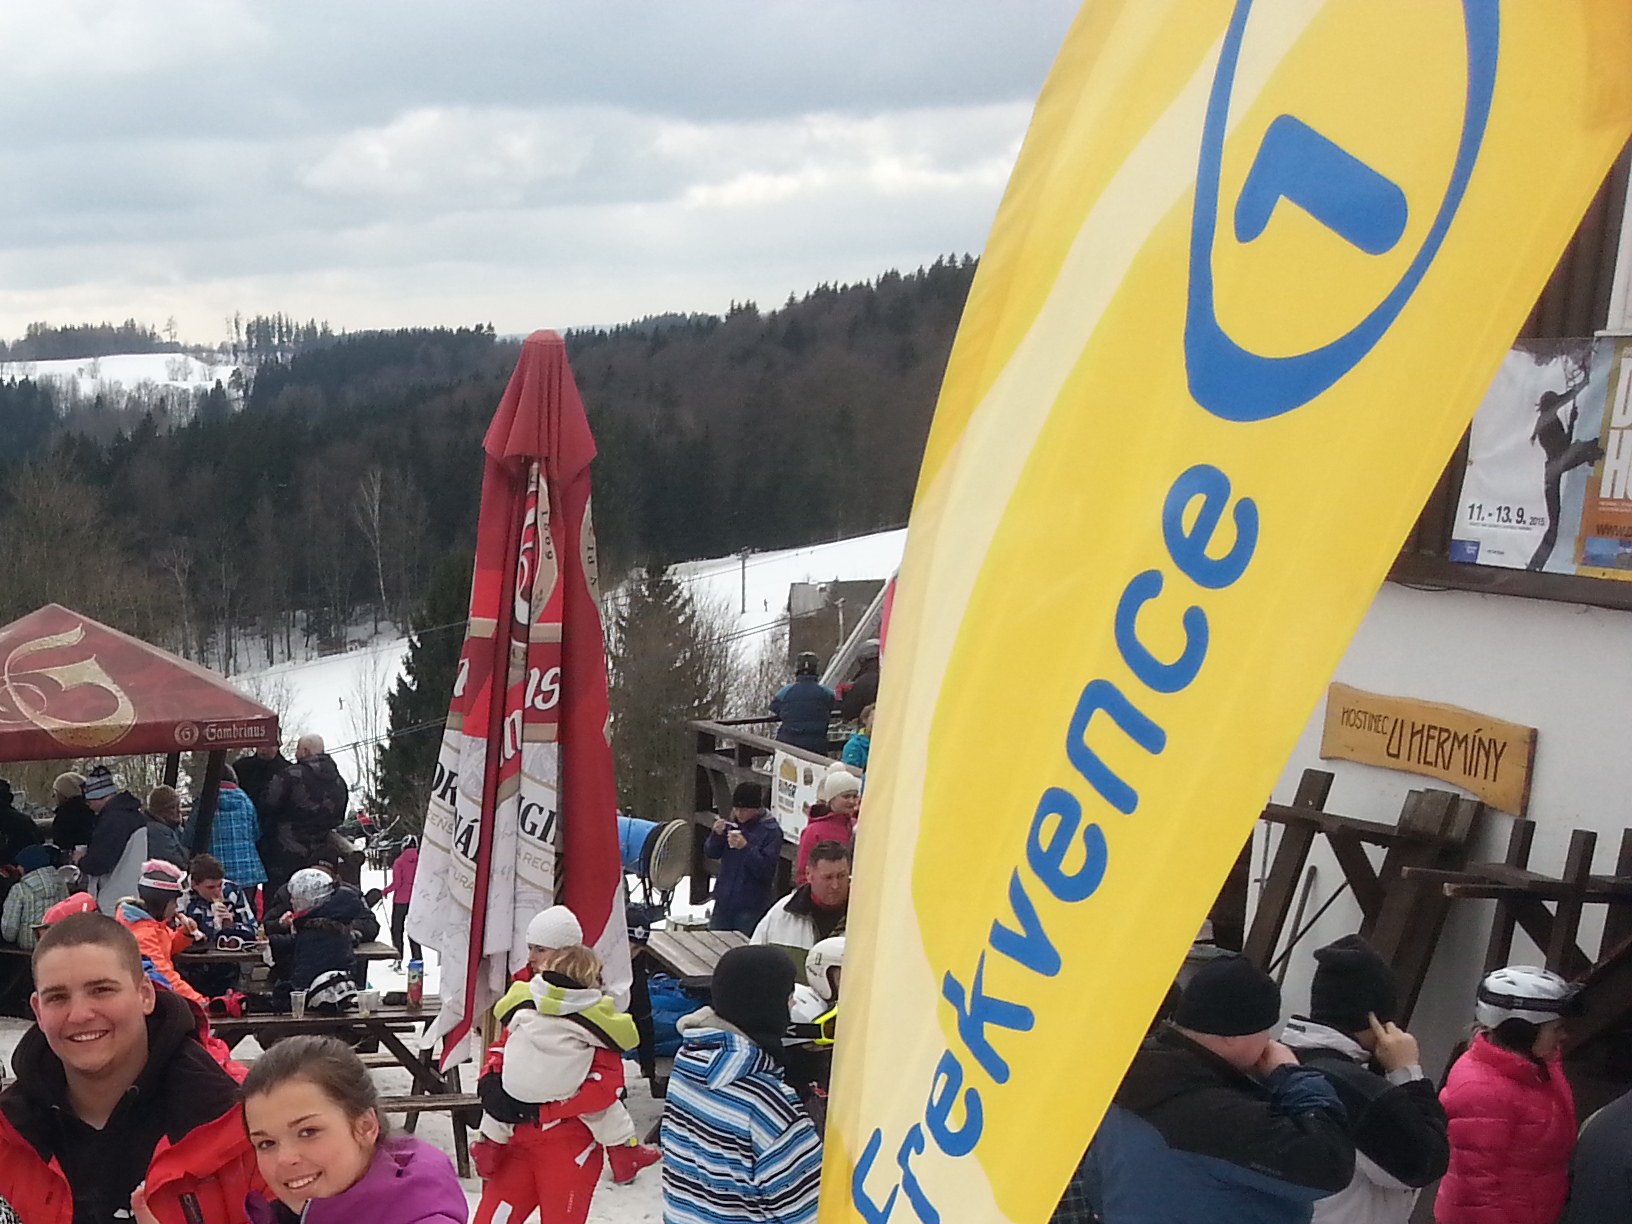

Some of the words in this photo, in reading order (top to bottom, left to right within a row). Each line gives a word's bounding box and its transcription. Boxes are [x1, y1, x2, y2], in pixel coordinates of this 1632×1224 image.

[205, 723, 266, 741] Gambrinus
[1341, 706, 1390, 736] HOSTINEC
[1385, 718, 1405, 760] U
[1407, 721, 1507, 783] HERMÍNY
